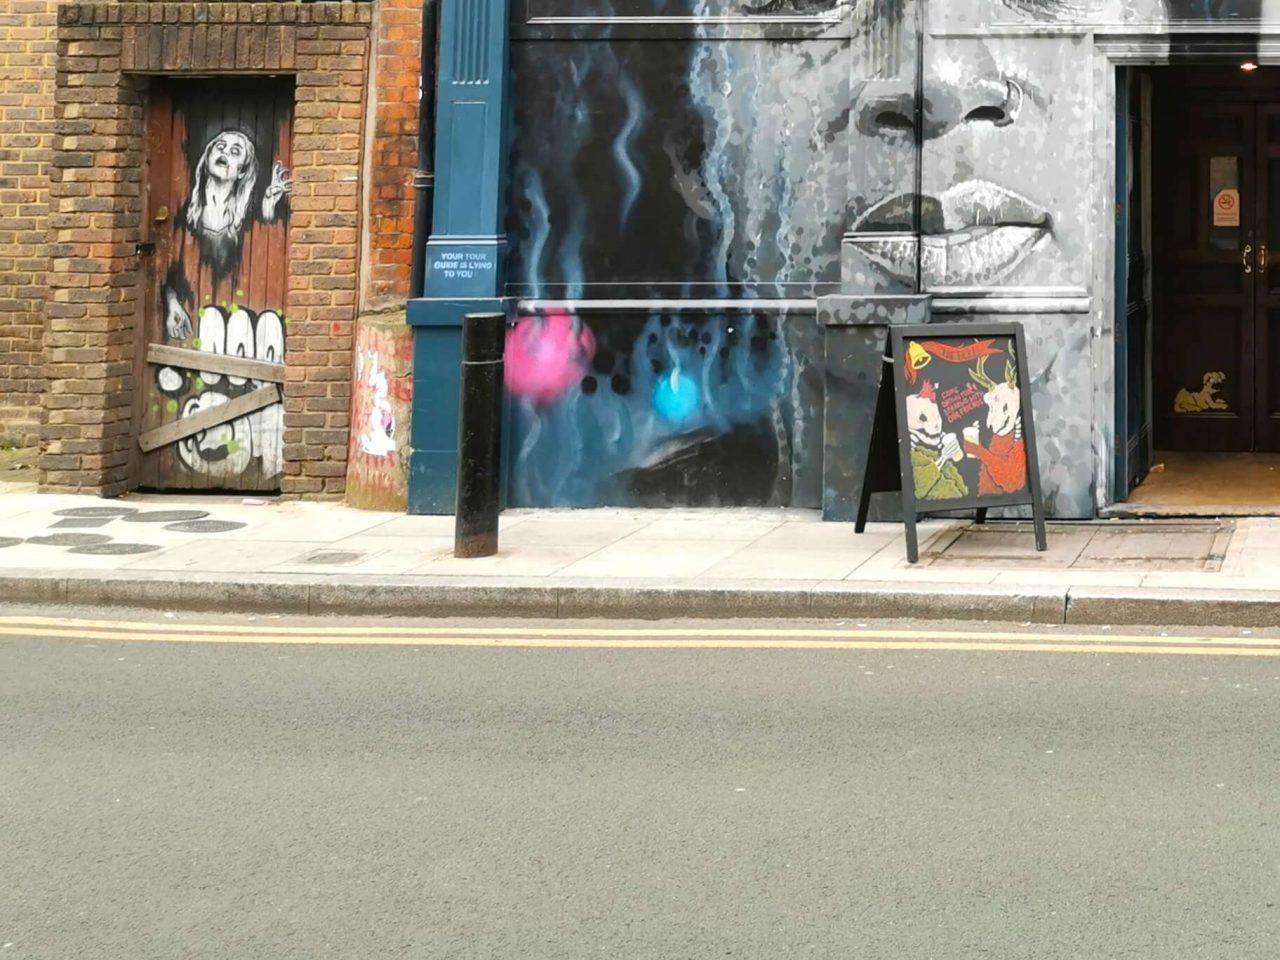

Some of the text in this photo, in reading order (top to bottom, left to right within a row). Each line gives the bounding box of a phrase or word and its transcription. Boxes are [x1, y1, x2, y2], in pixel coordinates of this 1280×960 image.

[441, 252, 487, 261] YOUR TOUR
[434, 261, 459, 270] GUIDE
[459, 261, 468, 270] IS
[444, 270, 474, 279] TO YOU
